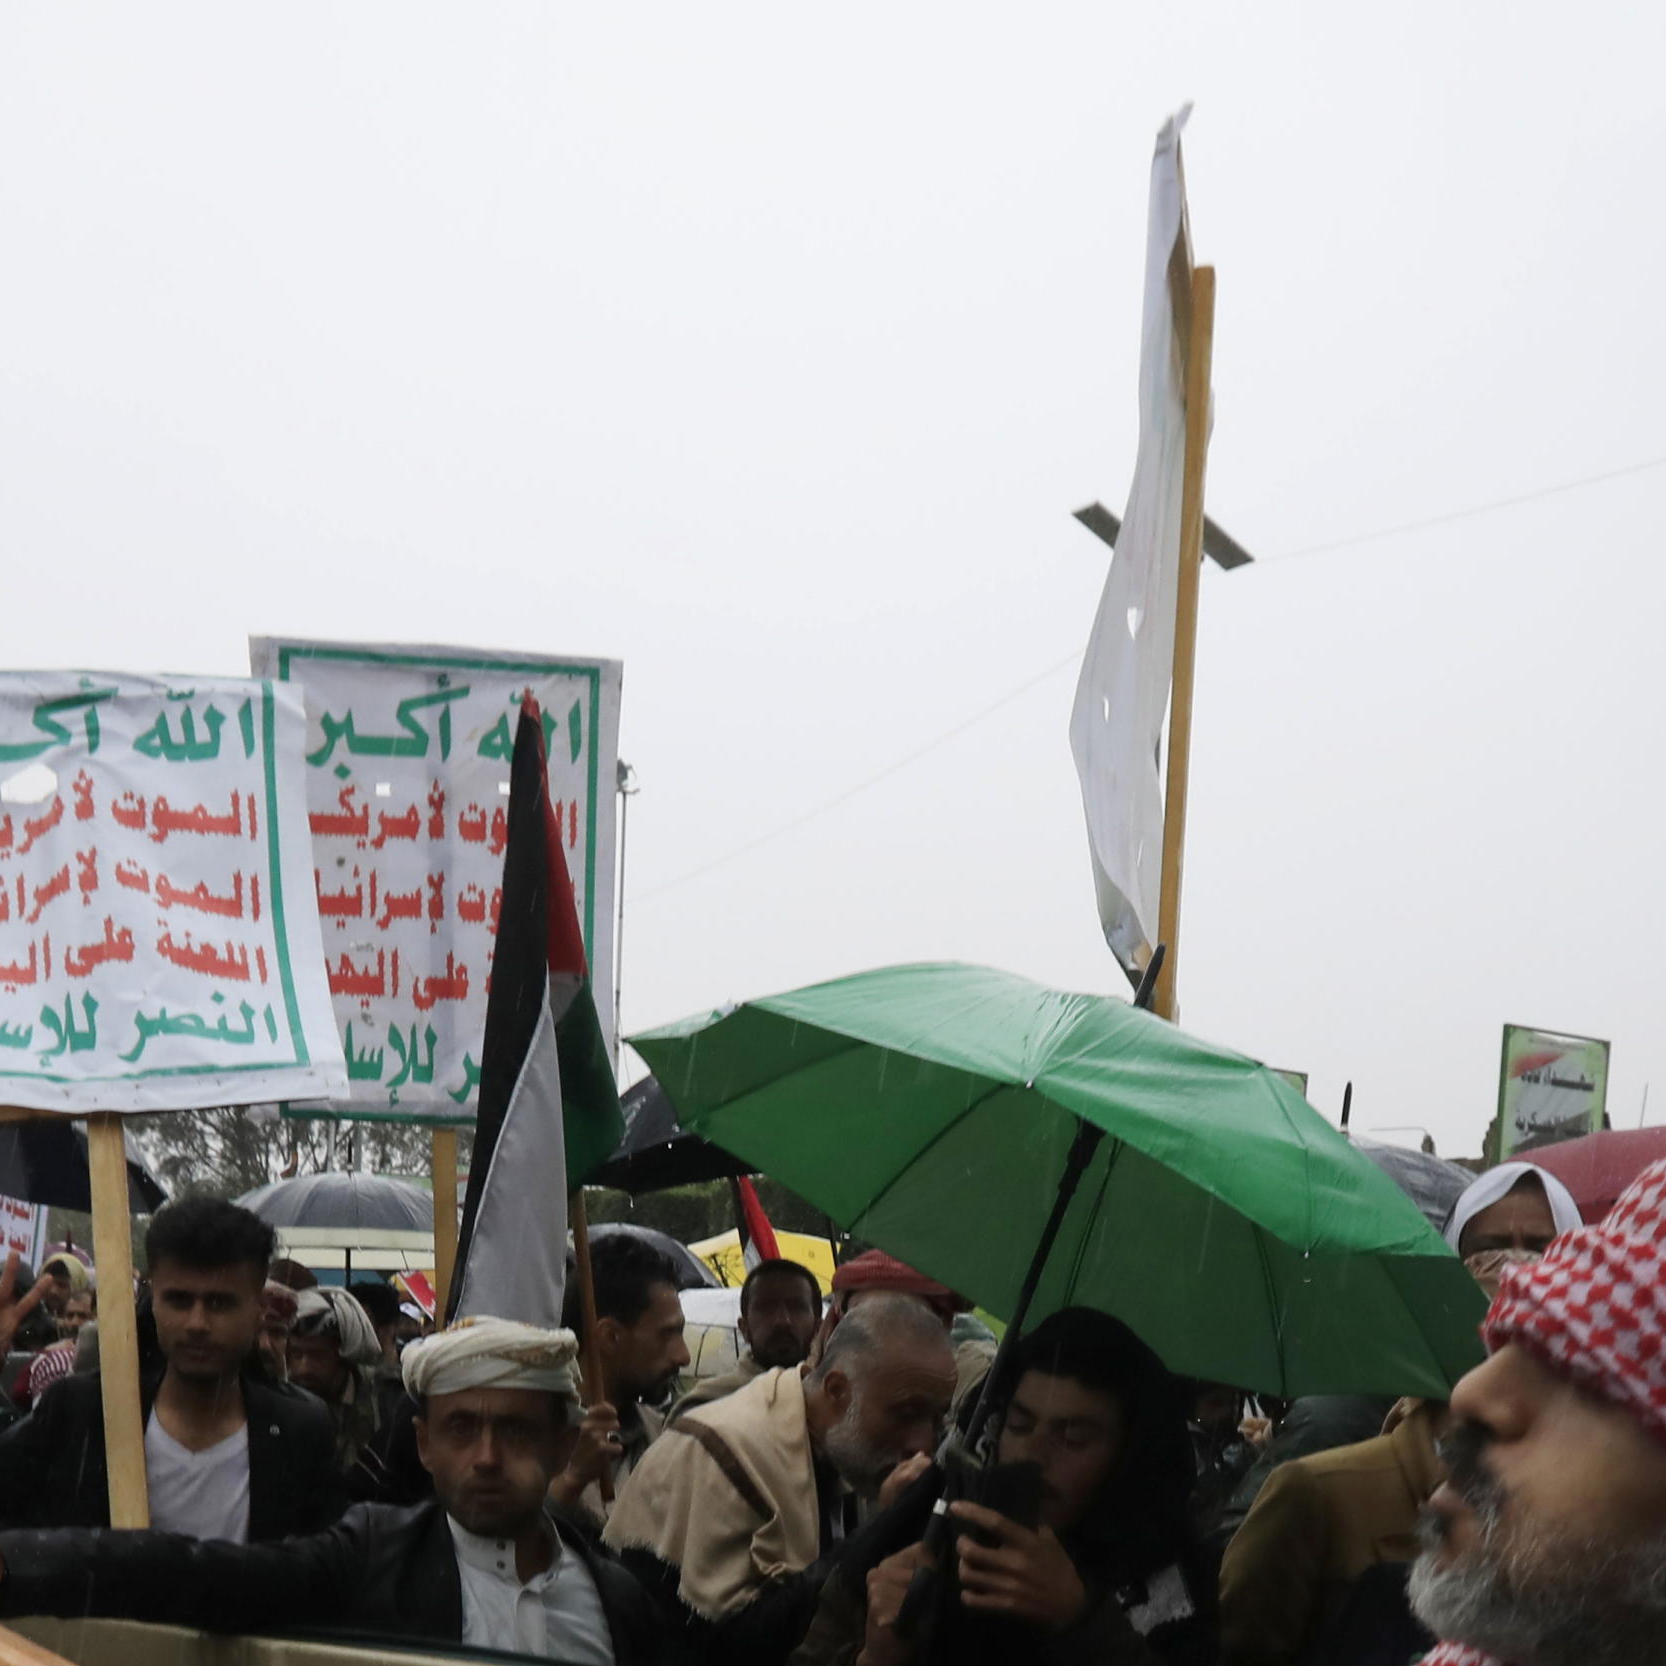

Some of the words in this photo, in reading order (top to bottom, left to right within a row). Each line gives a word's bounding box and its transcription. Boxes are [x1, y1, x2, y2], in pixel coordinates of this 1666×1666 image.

[132, 686, 256, 762] الله
[305, 673, 471, 780] أكبر
[477, 688, 582, 766] اله
[111, 788, 258, 844] الموت
[308, 777, 446, 851] لأمريك
[457, 798, 577, 858] الوت
[114, 858, 261, 923] الموت
[63, 914, 135, 979] على
[155, 918, 269, 986] اللعنة
[325, 946, 400, 1009] اليه
[412, 948, 469, 1012] على
[117, 989, 279, 1062] النصر
[344, 1018, 438, 1107] للإسل
